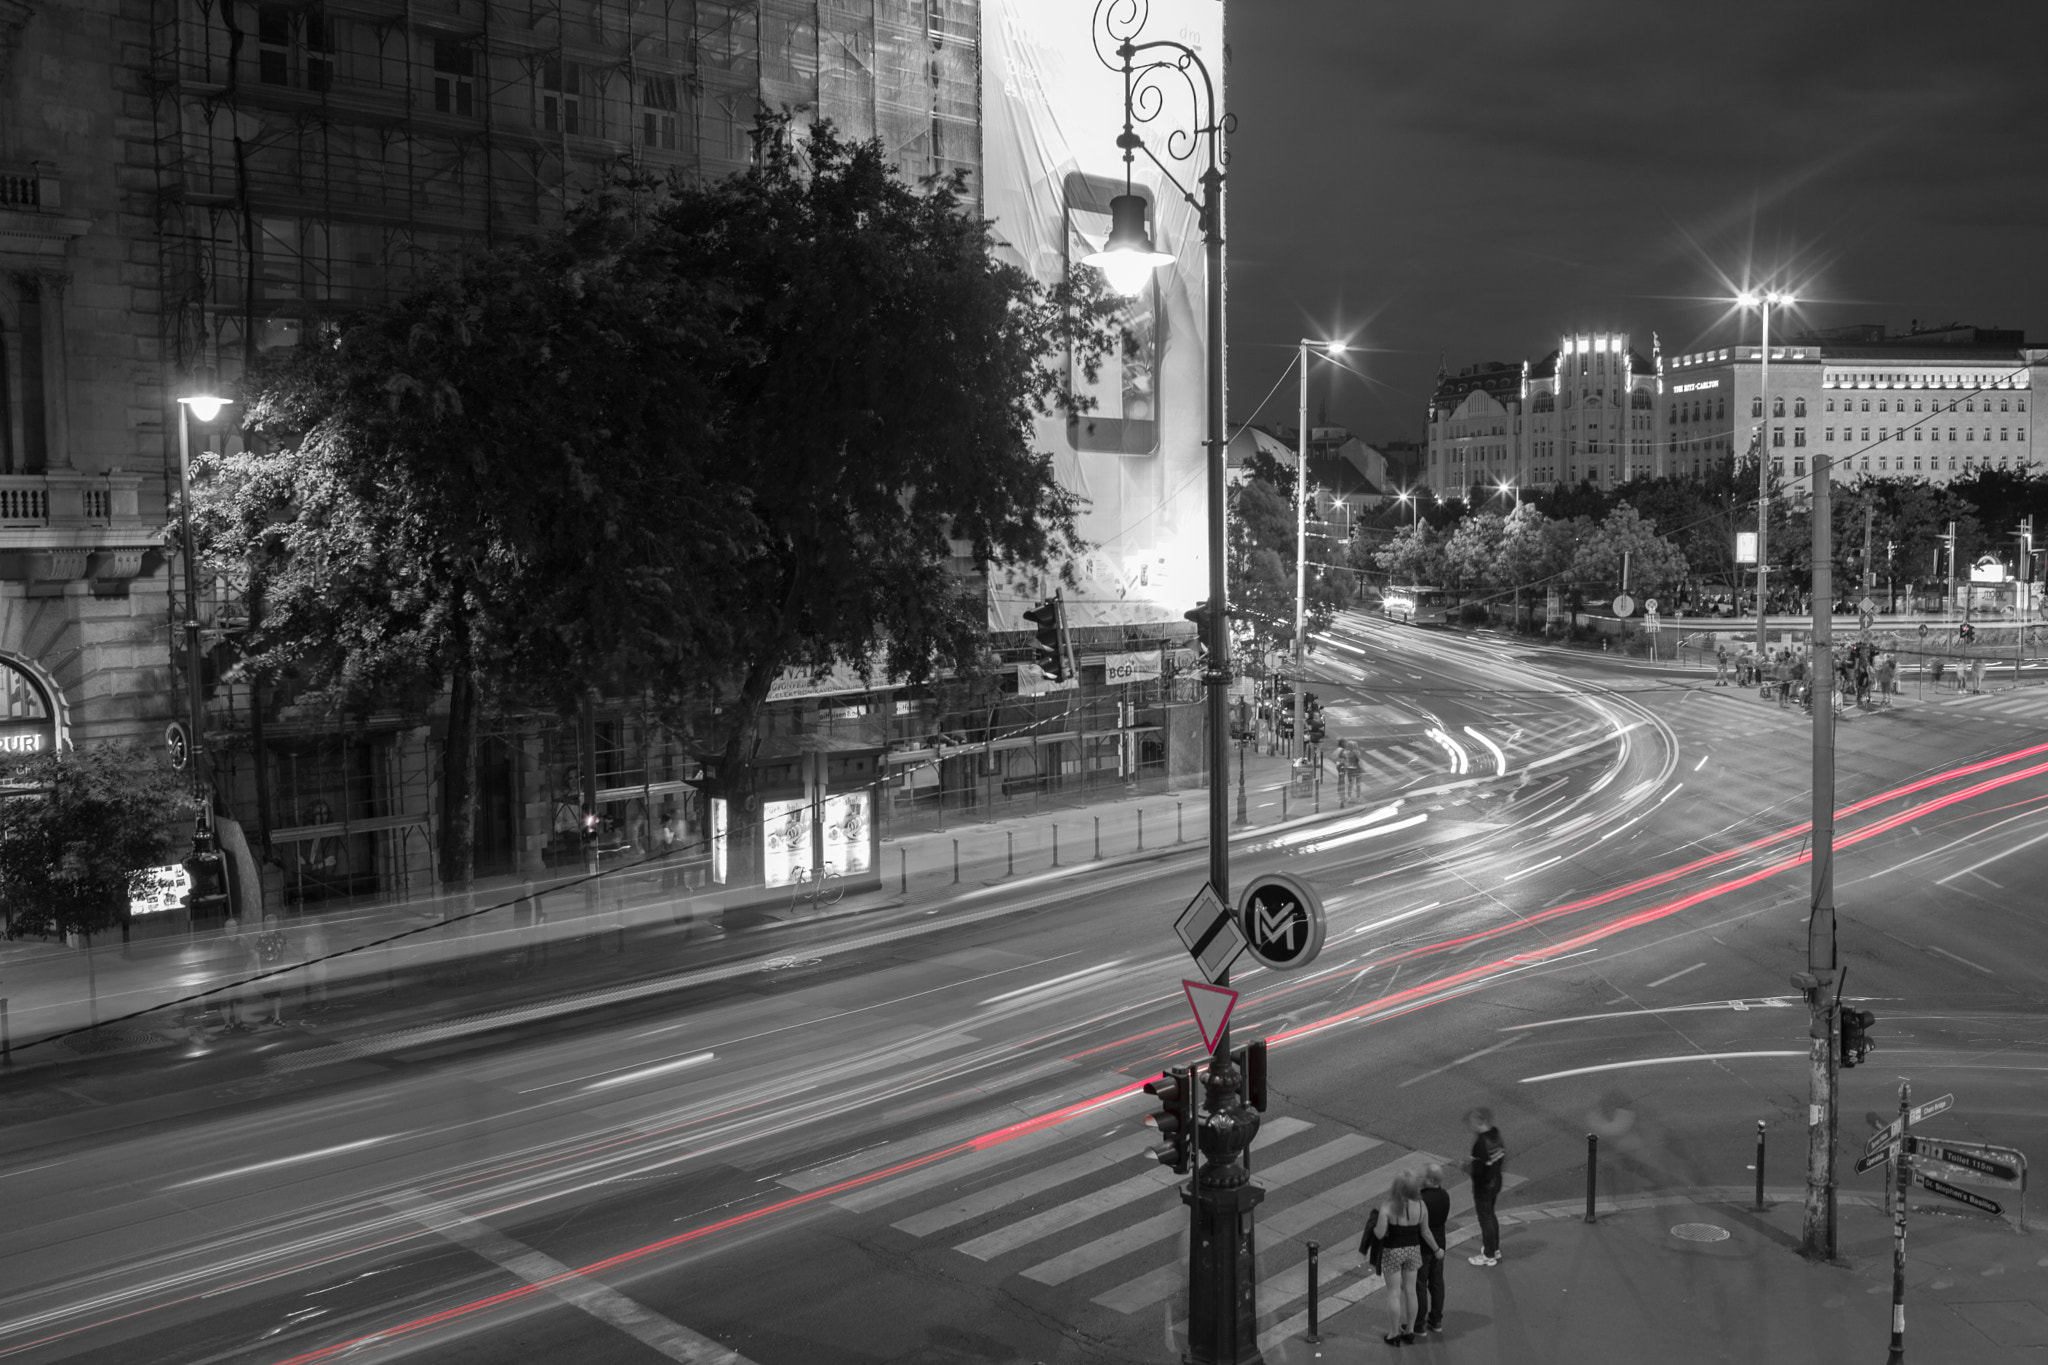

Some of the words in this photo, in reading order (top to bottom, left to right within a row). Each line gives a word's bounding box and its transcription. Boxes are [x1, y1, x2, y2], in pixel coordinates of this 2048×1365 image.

[1178, 24, 1201, 44] dm
[1673, 385, 1683, 394] THE
[1684, 380, 1719, 392] RITZ-CARLTON
[1109, 665, 1132, 679] BCD
[1946, 1152, 1970, 1165] Toilet
[1971, 1160, 1994, 1173] 115m
[1924, 1177, 1934, 1187] St.
[1935, 1183, 1968, 1201] Stephen's
[1969, 1195, 1997, 1211] Basilica
